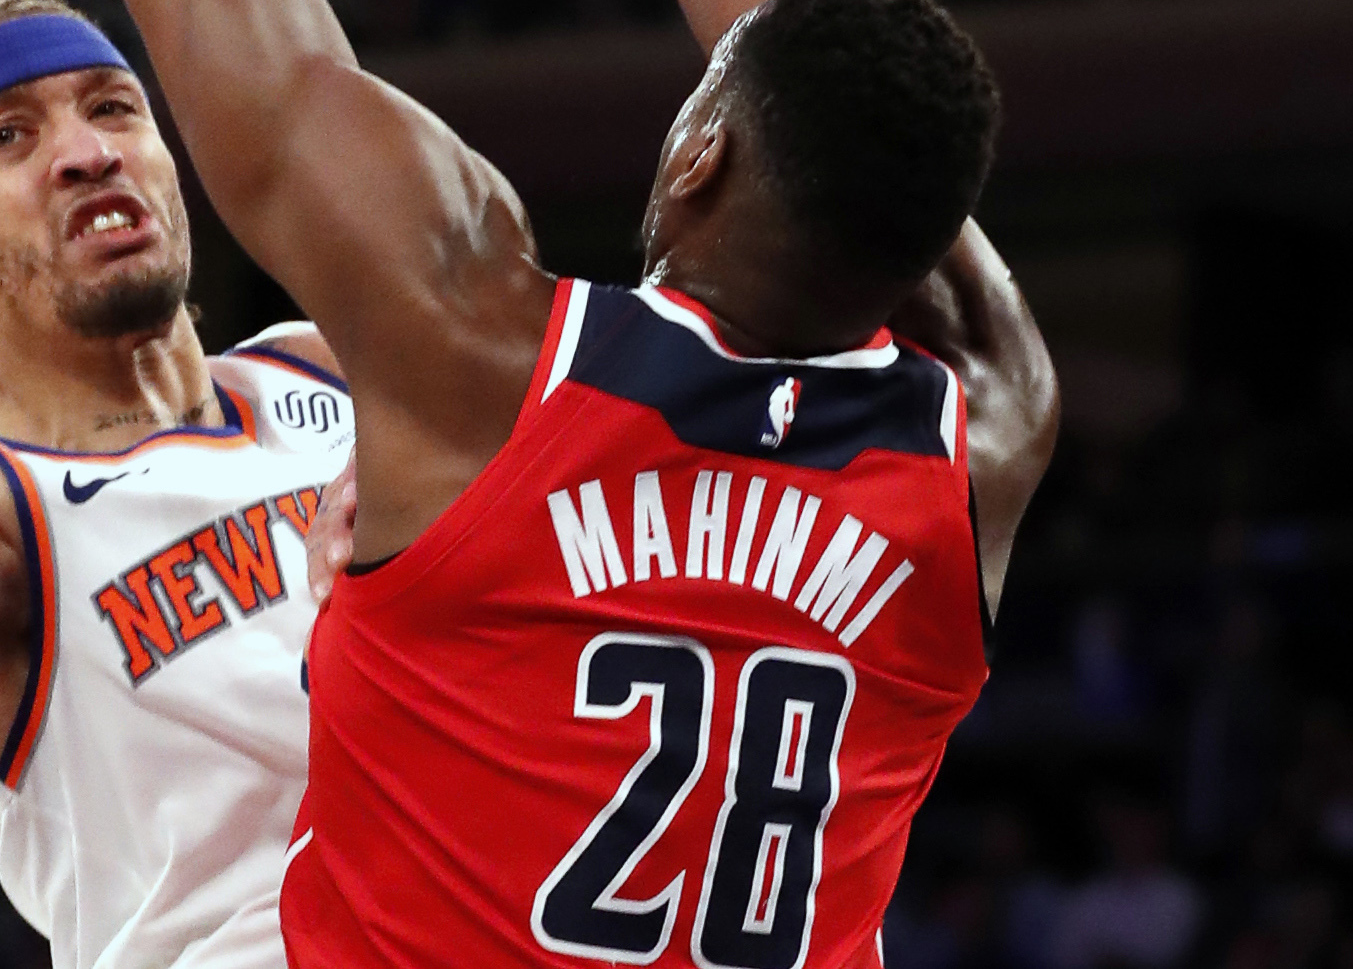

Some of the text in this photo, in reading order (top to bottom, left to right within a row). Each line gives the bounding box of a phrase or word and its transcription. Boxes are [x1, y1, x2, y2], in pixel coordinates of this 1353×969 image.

[90, 496, 289, 689] NEW
[547, 469, 915, 648] MAHINMI
[530, 631, 856, 969] 28
